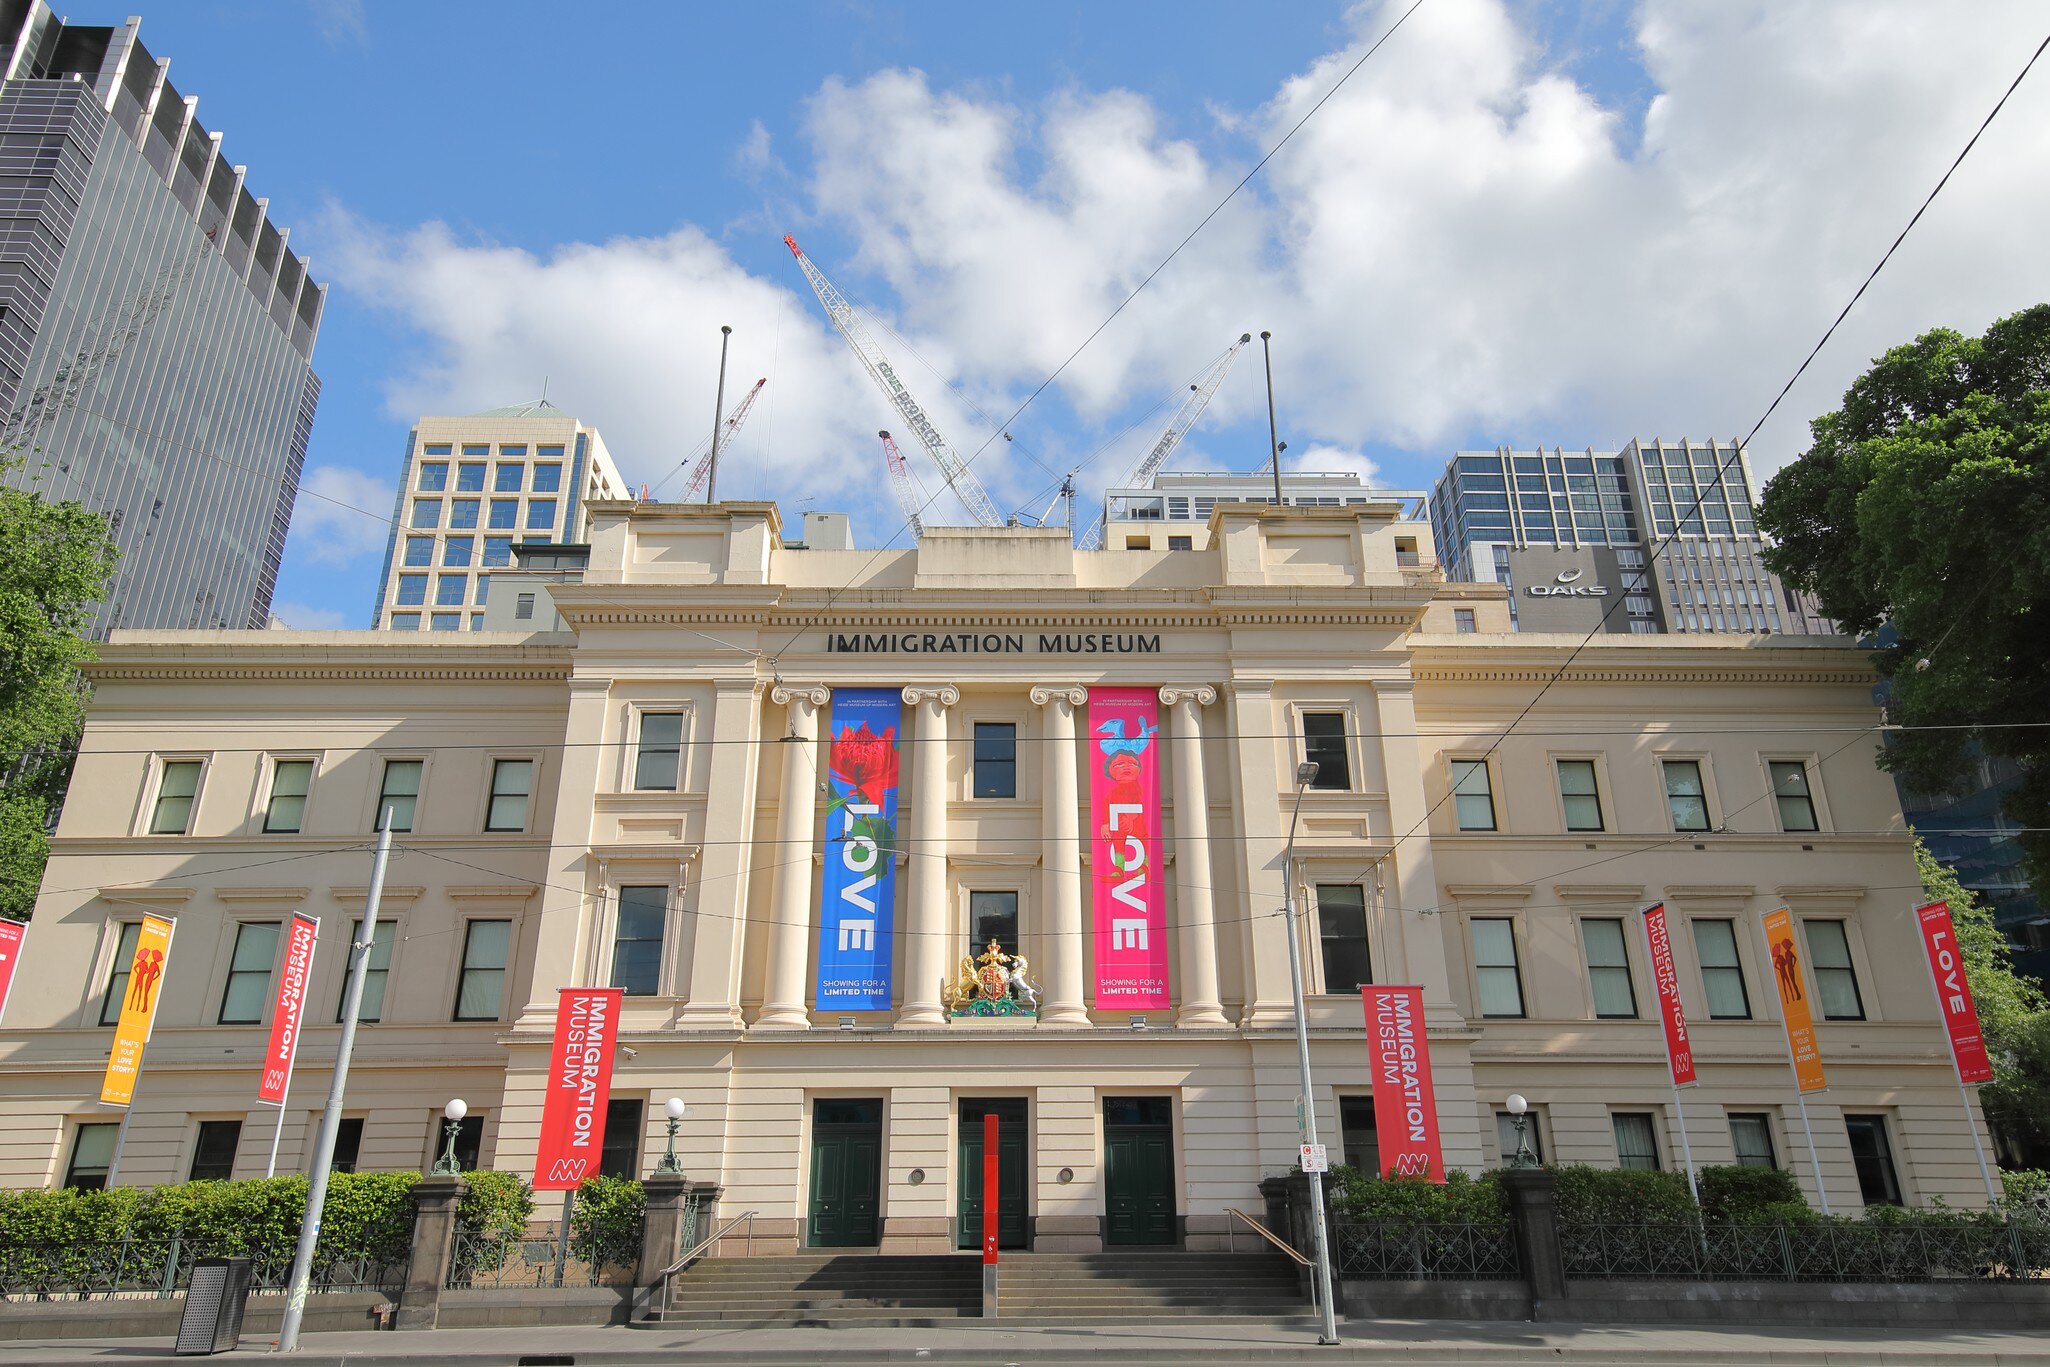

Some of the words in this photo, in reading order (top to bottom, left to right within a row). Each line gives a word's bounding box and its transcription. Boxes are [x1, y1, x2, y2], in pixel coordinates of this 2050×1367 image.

[1530, 586, 1608, 596] OAKS
[827, 634, 1024, 654] IMMIGRATION
[1039, 634, 1161, 654] MUSEUM
[838, 803, 880, 952] LOVE
[1108, 803, 1149, 951] LOVE
[279, 927, 311, 1060] IMMIGRATION
[281, 924, 304, 1007] MUSEUM
[1648, 916, 1670, 995] MUSEUM
[1655, 912, 1686, 1042] IMMIGRATION
[1932, 931, 1966, 1015] LOVE
[111, 1064, 135, 1074] STORY?
[117, 1056, 133, 1065] LOVE
[561, 996, 590, 1088] MUSEUM
[572, 996, 608, 1147] IMMIGRATION
[1375, 993, 1400, 1085] MUSEUM
[1393, 993, 1426, 1142] IMMIGRATION
[1796, 1053, 1816, 1063] STORY?
[1797, 1045, 1812, 1054] LOVE
